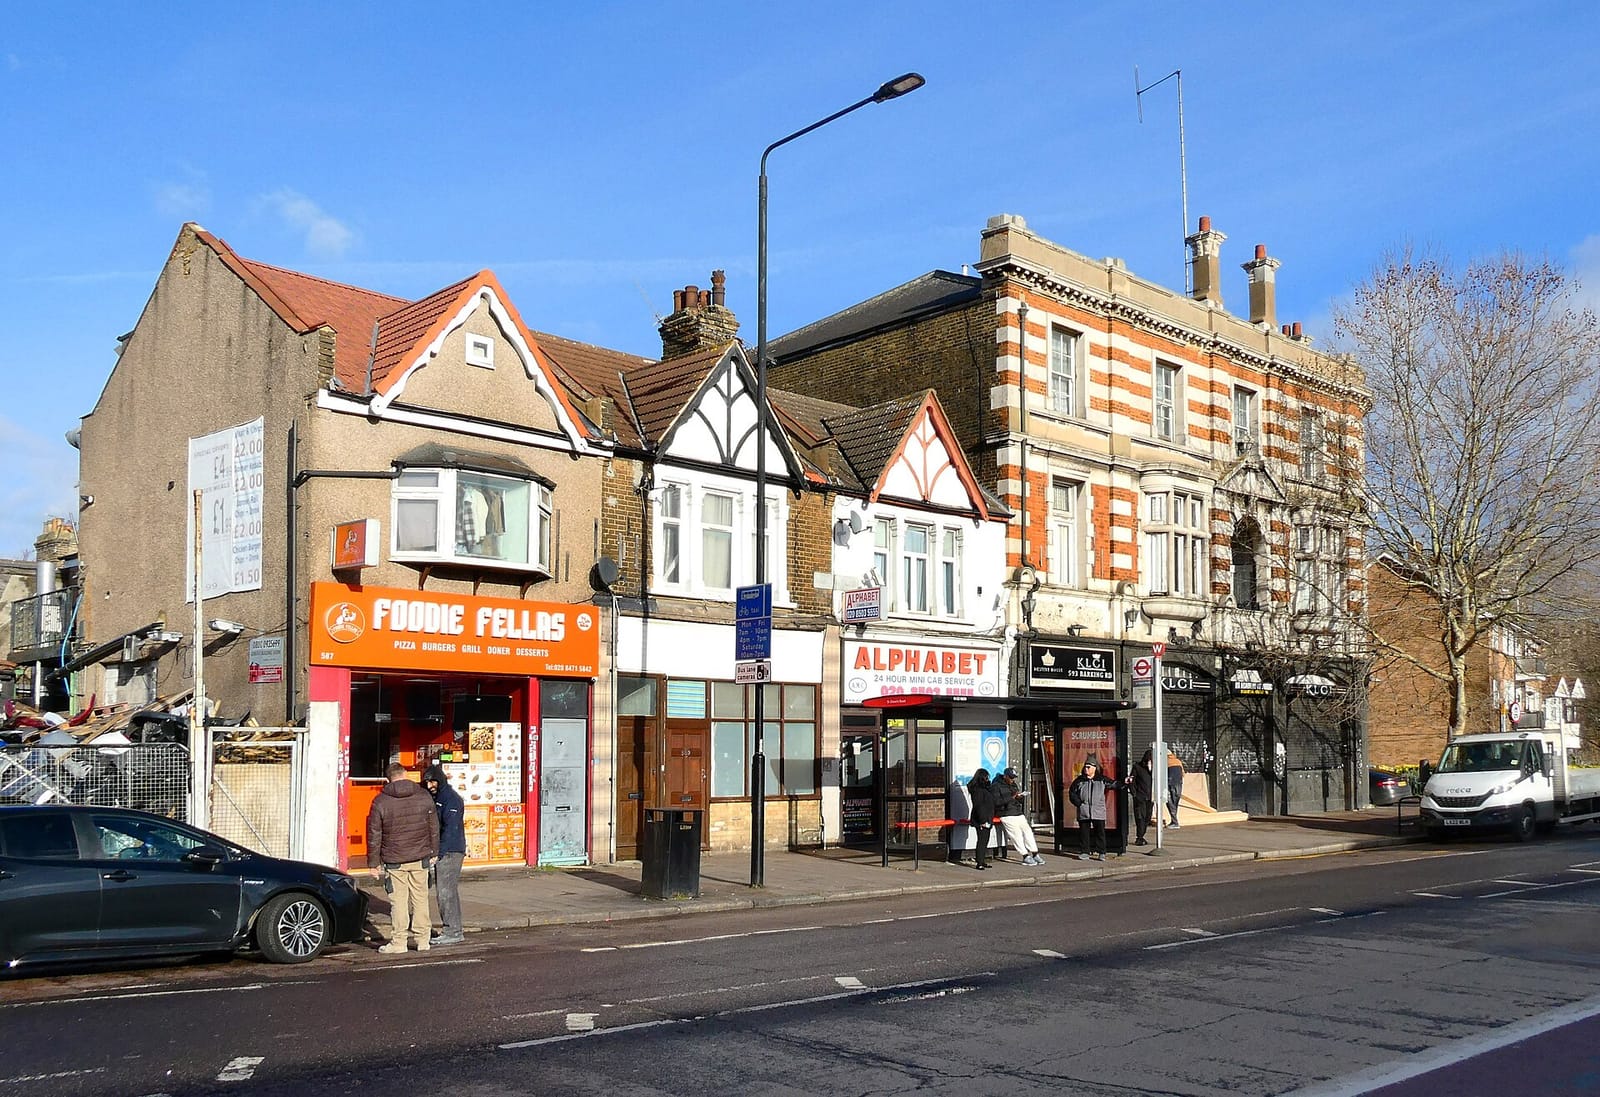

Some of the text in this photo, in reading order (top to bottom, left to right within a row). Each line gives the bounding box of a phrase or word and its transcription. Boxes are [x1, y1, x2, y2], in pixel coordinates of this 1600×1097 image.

[234, 439, 262, 458] £2.00
[234, 472, 262, 493] £2.00
[233, 520, 262, 539] £2.00
[234, 569, 260, 586] £1.50
[847, 591, 878, 608] ALPHABET
[372, 598, 465, 636] FOODIE
[476, 606, 565, 642] FELLAS
[394, 640, 549, 657] PIZZA BURGERS GRILL DONER DESSERTS
[1152, 644, 1162, 653] W
[854, 646, 987, 675] ALPHABET
[1077, 657, 1106, 669] KLCI
[874, 674, 975, 686] 24 HOUR MINI CAB SERVICE
[1079, 670, 1104, 678] BARKING
[1071, 731, 1108, 740] SCRUMBLES
